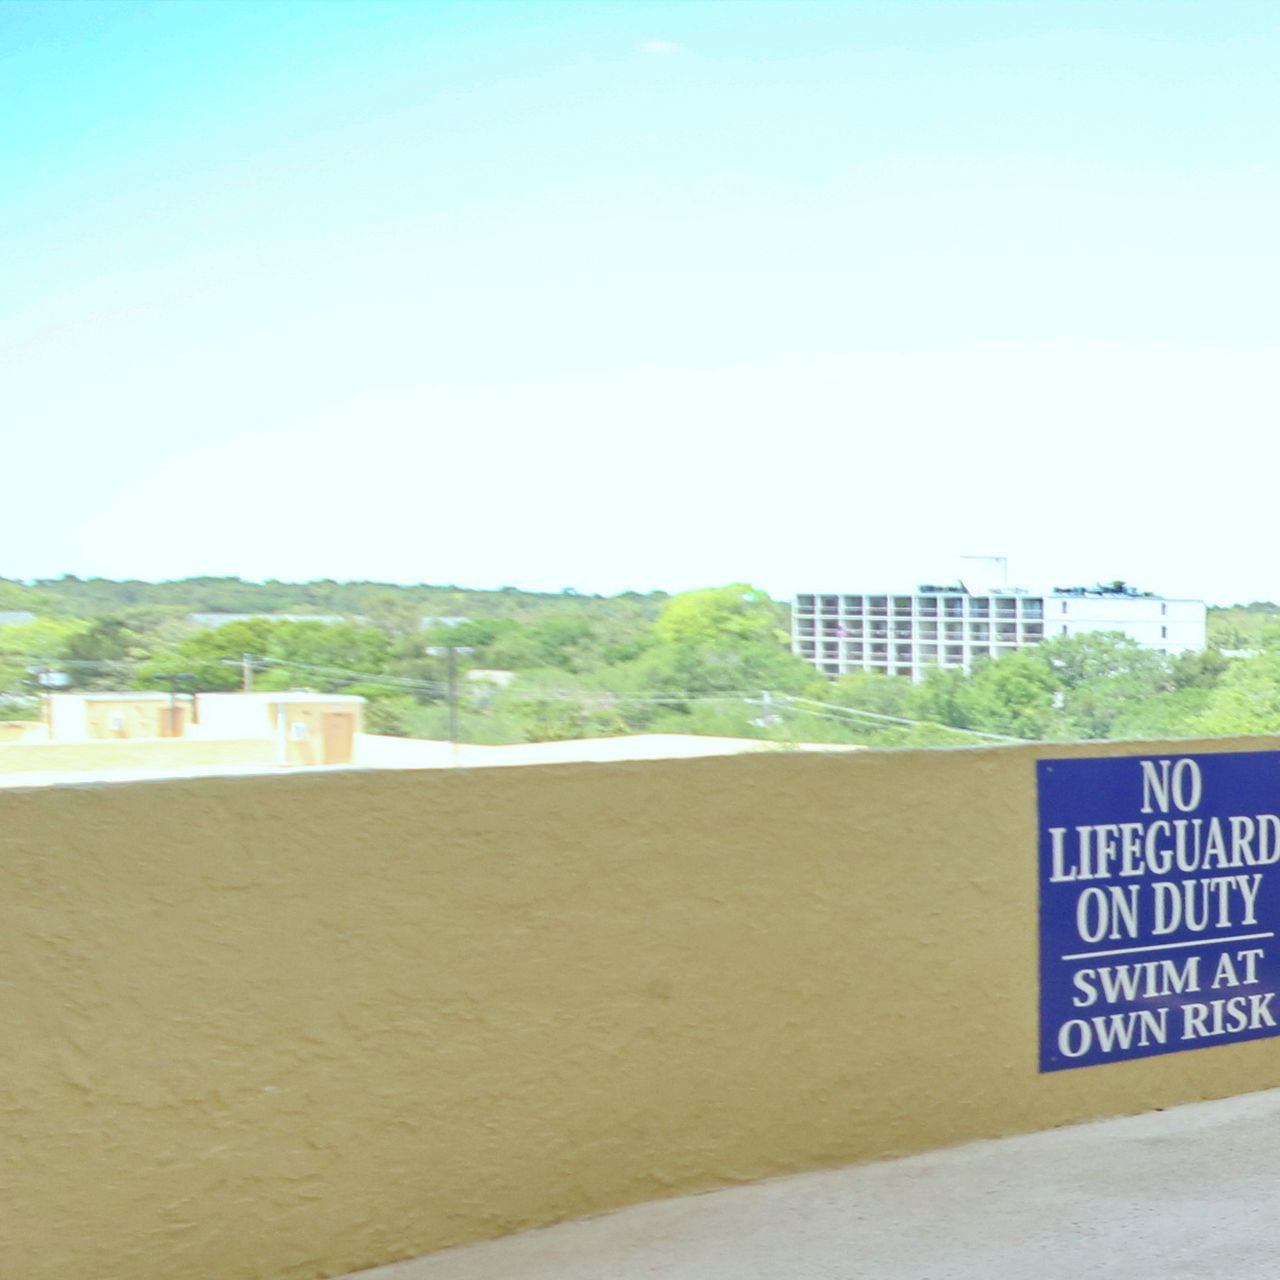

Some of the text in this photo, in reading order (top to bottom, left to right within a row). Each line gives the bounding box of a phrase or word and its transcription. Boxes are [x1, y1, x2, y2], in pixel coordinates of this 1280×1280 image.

[1140, 758, 1202, 814] NO
[1076, 873, 1262, 943] ON DUTY
[1072, 949, 1264, 1007] SWIM AT
[1058, 992, 1278, 1058] OWN RISK
